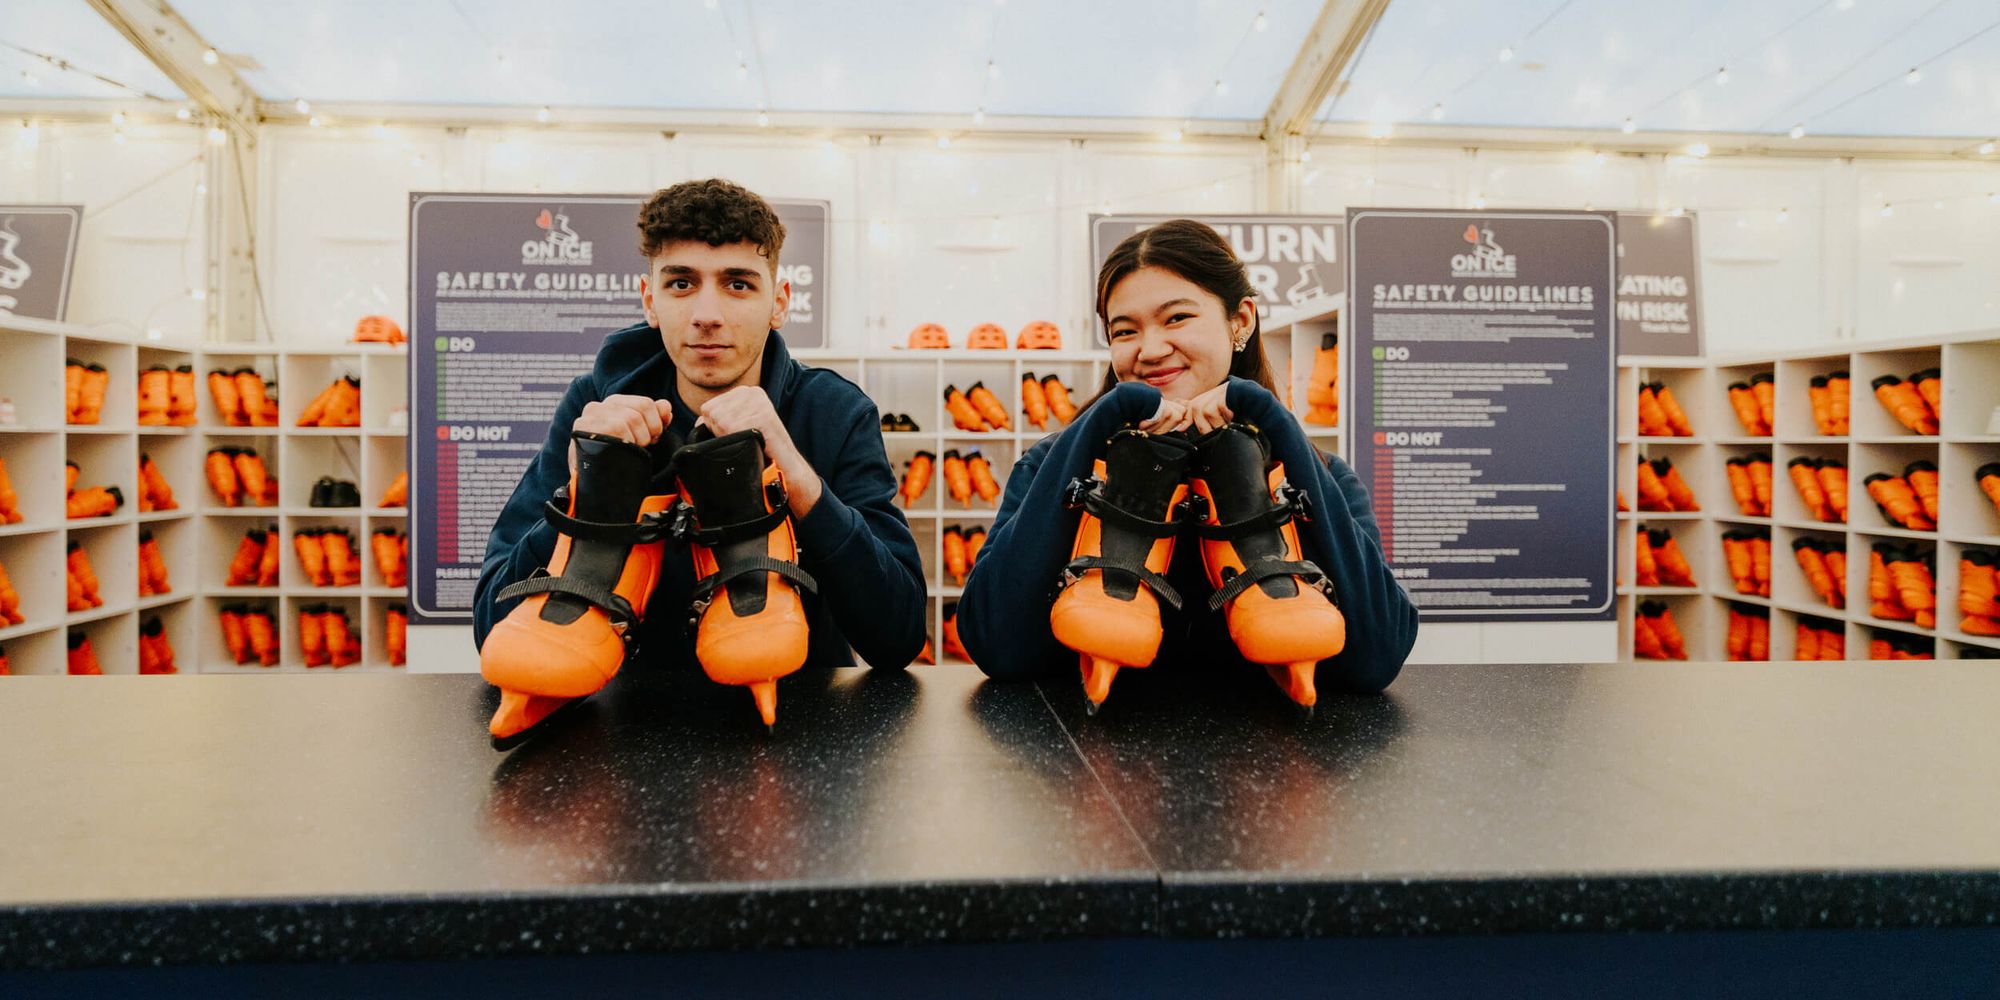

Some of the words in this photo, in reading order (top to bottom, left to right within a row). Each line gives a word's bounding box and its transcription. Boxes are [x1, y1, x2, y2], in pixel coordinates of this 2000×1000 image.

[521, 240, 555, 258] ON
[558, 241, 593, 259] ICE
[1450, 254, 1482, 272] ON
[1484, 254, 1517, 273] ICE
[436, 271, 527, 289] SAFETY
[1373, 284, 1457, 301] SAFETY
[1463, 285, 1594, 303] GUIDELINES
[1640, 302, 1688, 322] RISK
[449, 337, 476, 353] DO
[1385, 346, 1410, 361] DO
[449, 426, 476, 441] DO
[477, 426, 512, 441] NOT
[1385, 431, 1410, 446] DO
[1411, 431, 1443, 446] NOT
